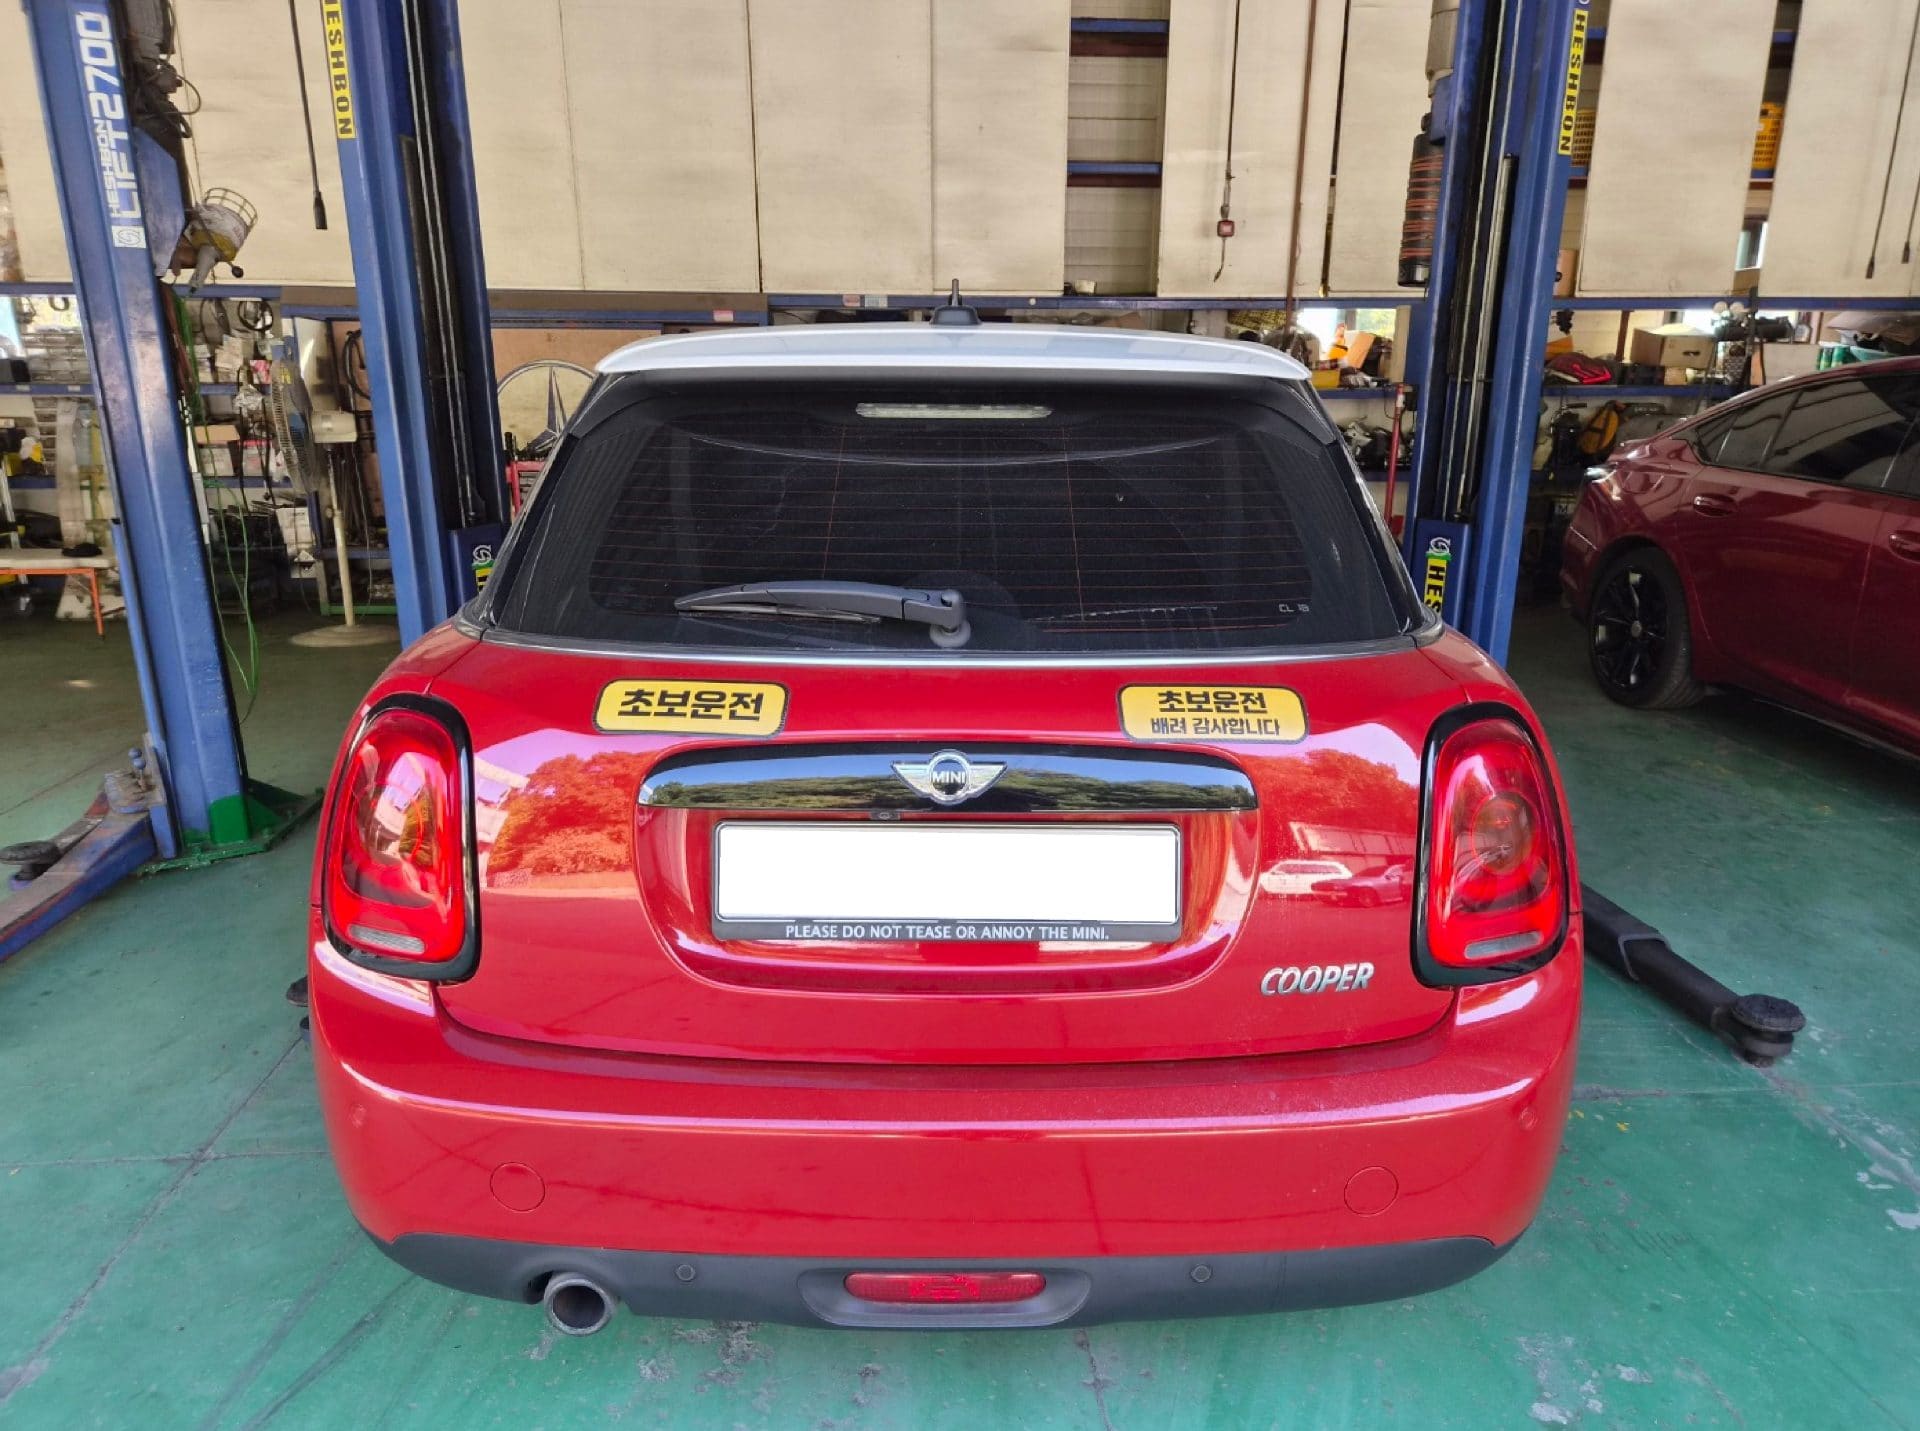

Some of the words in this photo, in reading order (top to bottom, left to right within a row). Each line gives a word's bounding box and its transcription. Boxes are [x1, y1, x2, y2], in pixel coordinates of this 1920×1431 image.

[1560, 13, 1586, 151] HESHBON
[94, 118, 121, 217] HESHBON
[617, 689, 764, 722] 초보운전
[1158, 690, 1268, 714] 초보운전
[1150, 717, 1187, 735] 배려
[1192, 717, 1280, 736] 감사합니다
[932, 770, 967, 784] MINI
[785, 925, 838, 939] PLEASE
[842, 925, 865, 939] DO
[870, 925, 902, 939] NOT
[905, 925, 950, 939] TEASE
[955, 925, 978, 940] OR
[980, 926, 1035, 940] ANNOY
[1038, 926, 1069, 940] THE
[1072, 926, 1110, 940] MINI.
[1260, 962, 1375, 996] COOPER
